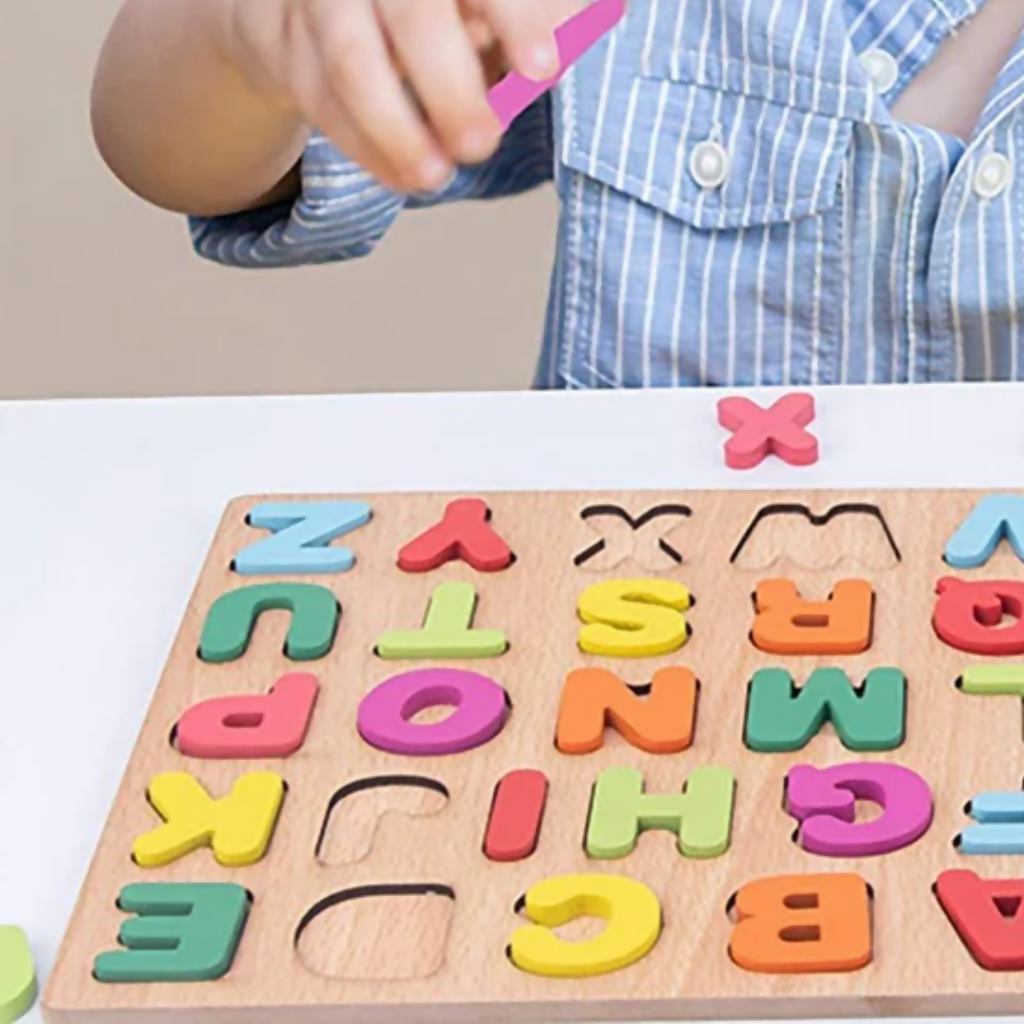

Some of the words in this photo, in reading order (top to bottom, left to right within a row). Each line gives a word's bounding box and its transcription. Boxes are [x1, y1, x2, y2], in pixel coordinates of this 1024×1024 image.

[717, 393, 819, 470] X
[233, 501, 372, 575] Z
[374, 581, 509, 659] T
[577, 578, 695, 656] S
[749, 578, 875, 655] R
[171, 672, 319, 759] P
[357, 668, 511, 756] O
[555, 666, 700, 754] N
[131, 772, 288, 867] K
[583, 765, 737, 859] H
[784, 762, 934, 856] G
[92, 882, 253, 983] E
[505, 874, 663, 977] C
[726, 873, 875, 973] B
